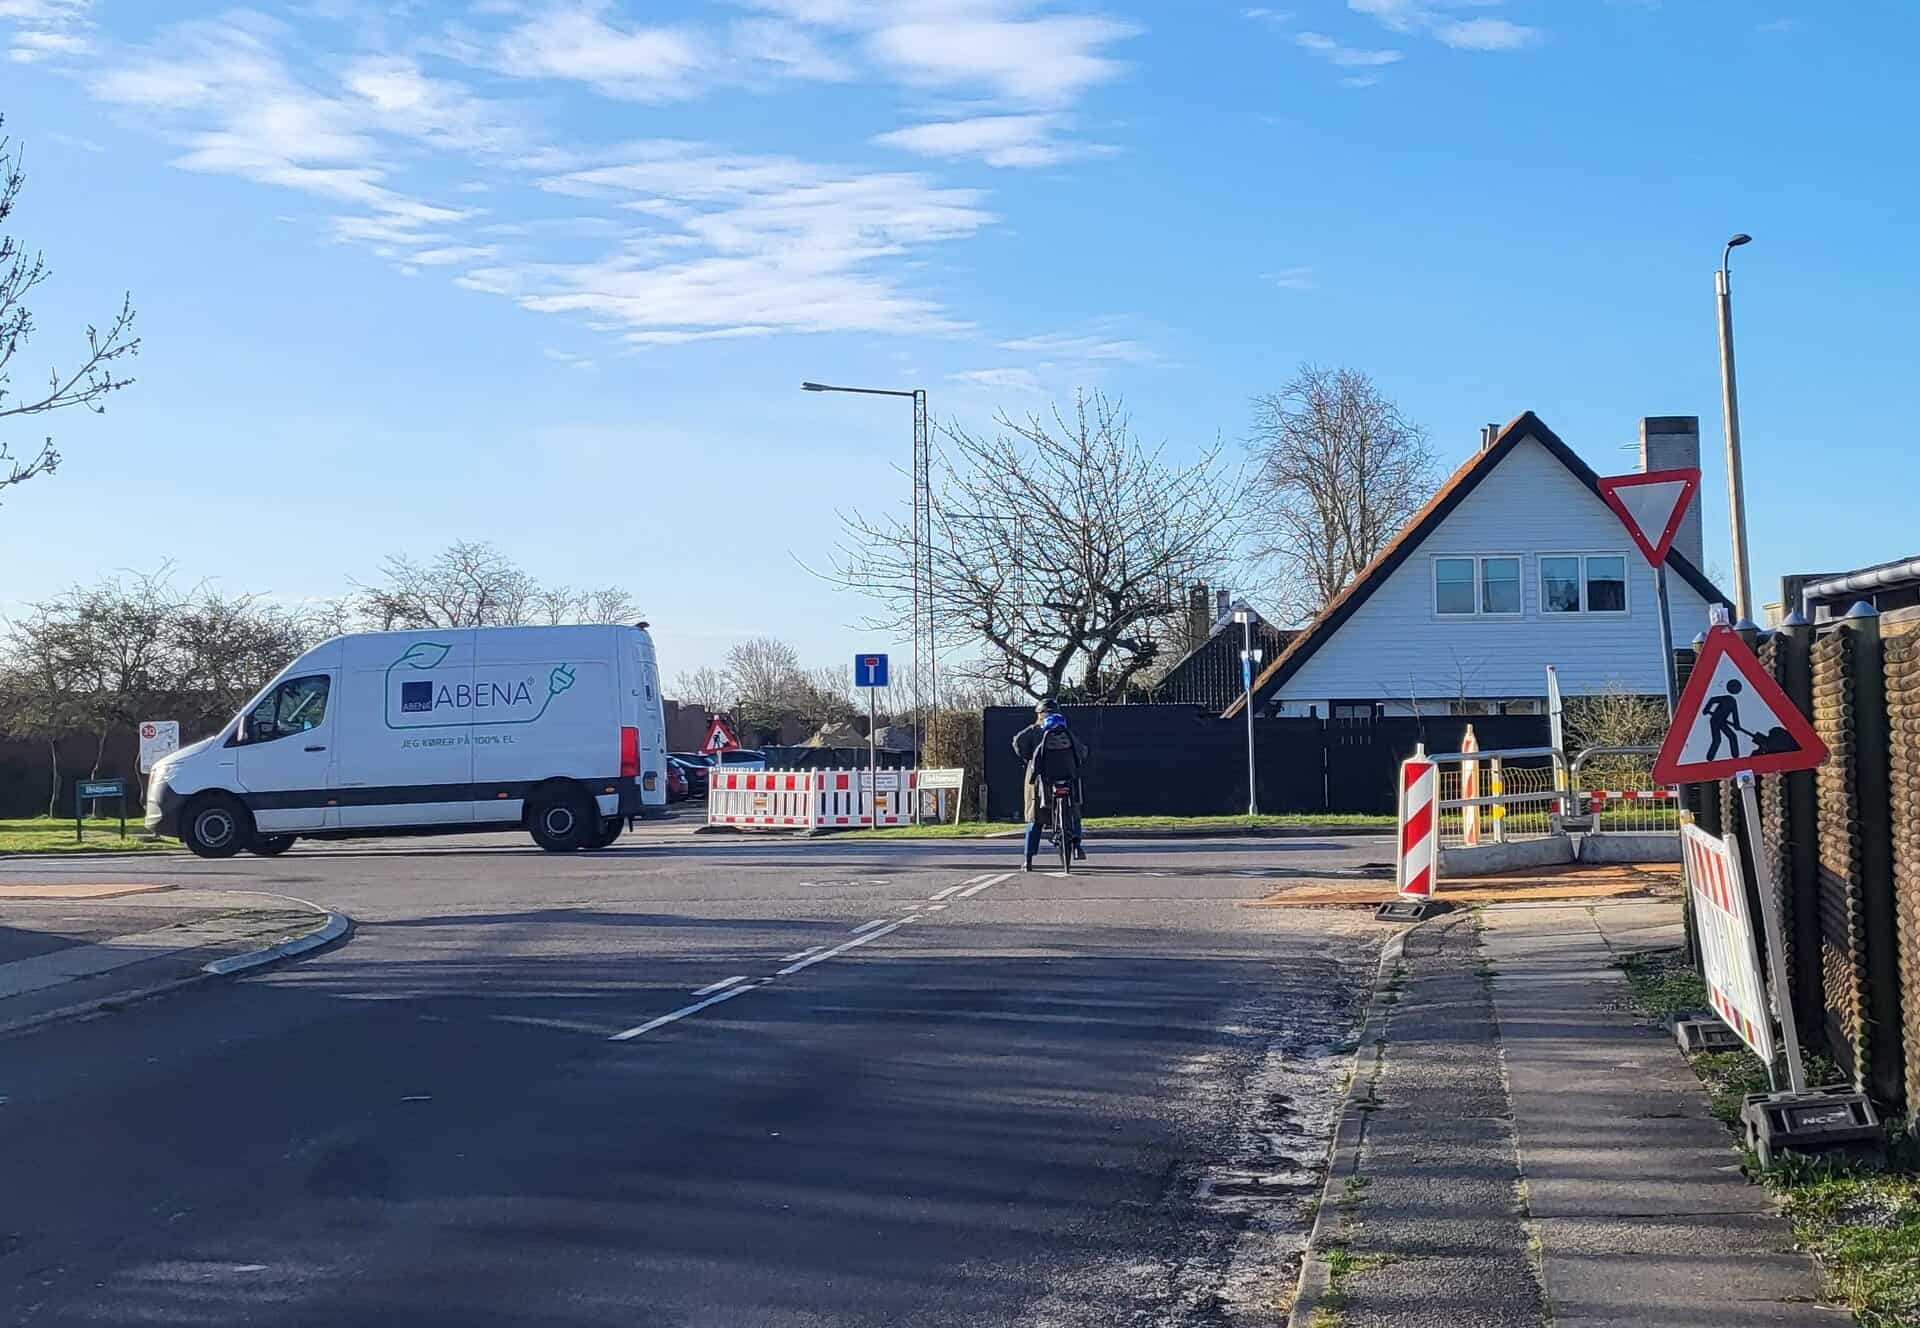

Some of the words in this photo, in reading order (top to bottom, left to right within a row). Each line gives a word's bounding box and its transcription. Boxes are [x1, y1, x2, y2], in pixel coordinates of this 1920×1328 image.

[434, 681, 532, 709] ABENA
[401, 738, 420, 748] JEG
[422, 737, 455, 748] KØRER
[457, 733, 471, 744] PÅ
[472, 735, 500, 745] 100%
[503, 735, 516, 744] EL
